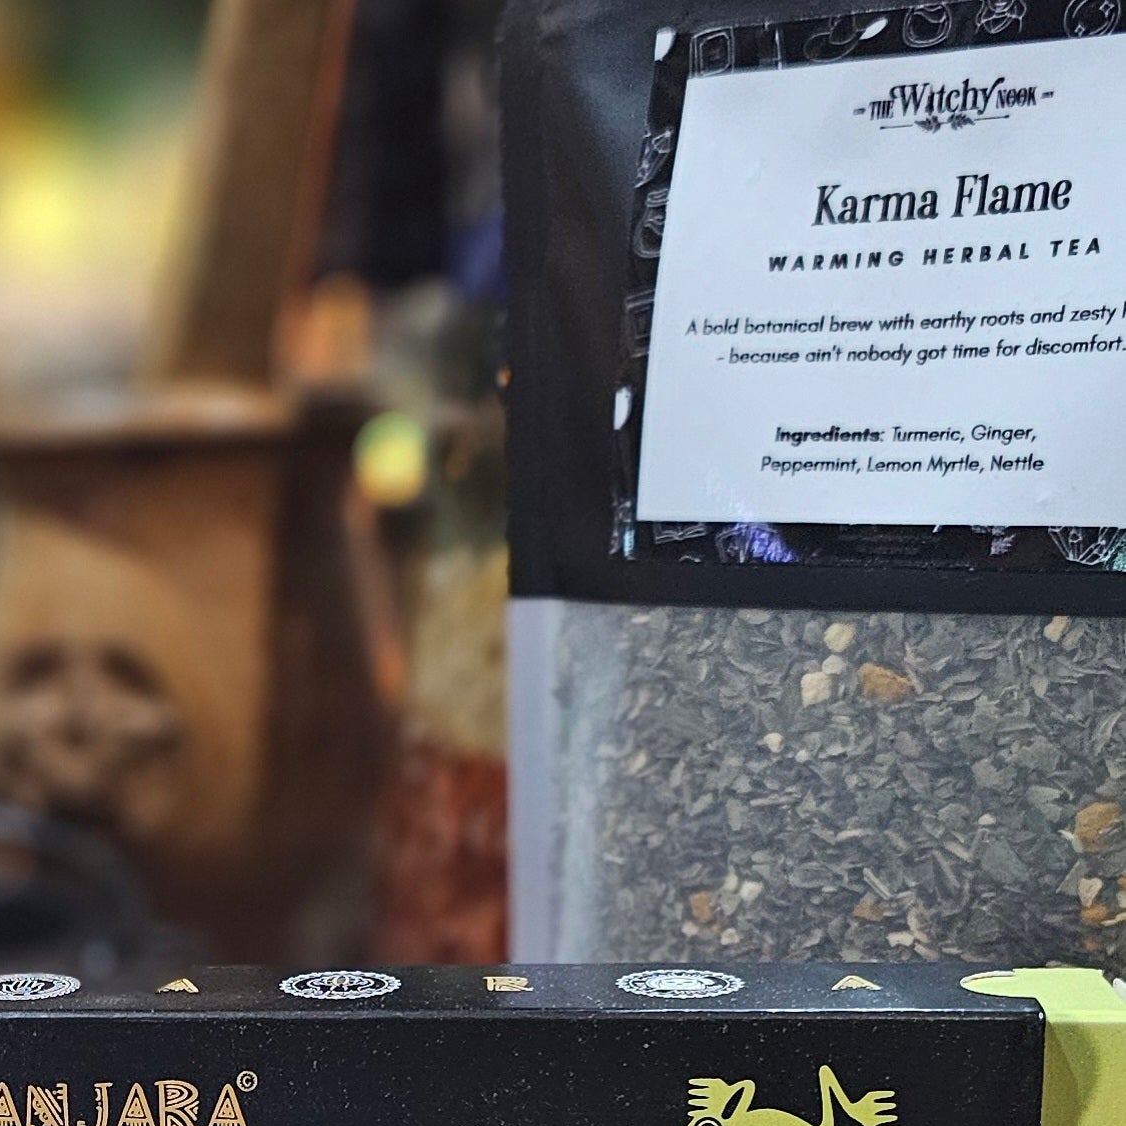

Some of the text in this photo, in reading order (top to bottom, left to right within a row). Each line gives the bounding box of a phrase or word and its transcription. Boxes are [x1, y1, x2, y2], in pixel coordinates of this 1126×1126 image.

[869, 100, 894, 120] THE
[889, 77, 1005, 116] Witchy
[811, 173, 1073, 227] Karma Flame
[769, 237, 1101, 272] WARMING HERBAL TEA
[685, 320, 698, 336] A
[702, 317, 740, 336] bold
[744, 315, 826, 335] botanical
[829, 315, 873, 333] brew
[878, 313, 915, 332] with
[920, 311, 977, 333] earthy
[980, 311, 1025, 327] roots
[1030, 305, 1066, 324] and
[1069, 304, 1117, 326] zesty
[728, 347, 800, 364] because
[805, 345, 842, 363] ain't
[846, 343, 912, 366] nobody
[916, 344, 948, 366] got
[952, 343, 991, 359] time
[995, 339, 1021, 357] for
[1025, 333, 1126, 355] discomfort.
[774, 424, 1037, 446] Ingredients: Turmeric, Ginger,
[760, 453, 1045, 477] Peppermint, Lemon Myrtle, Nettle
